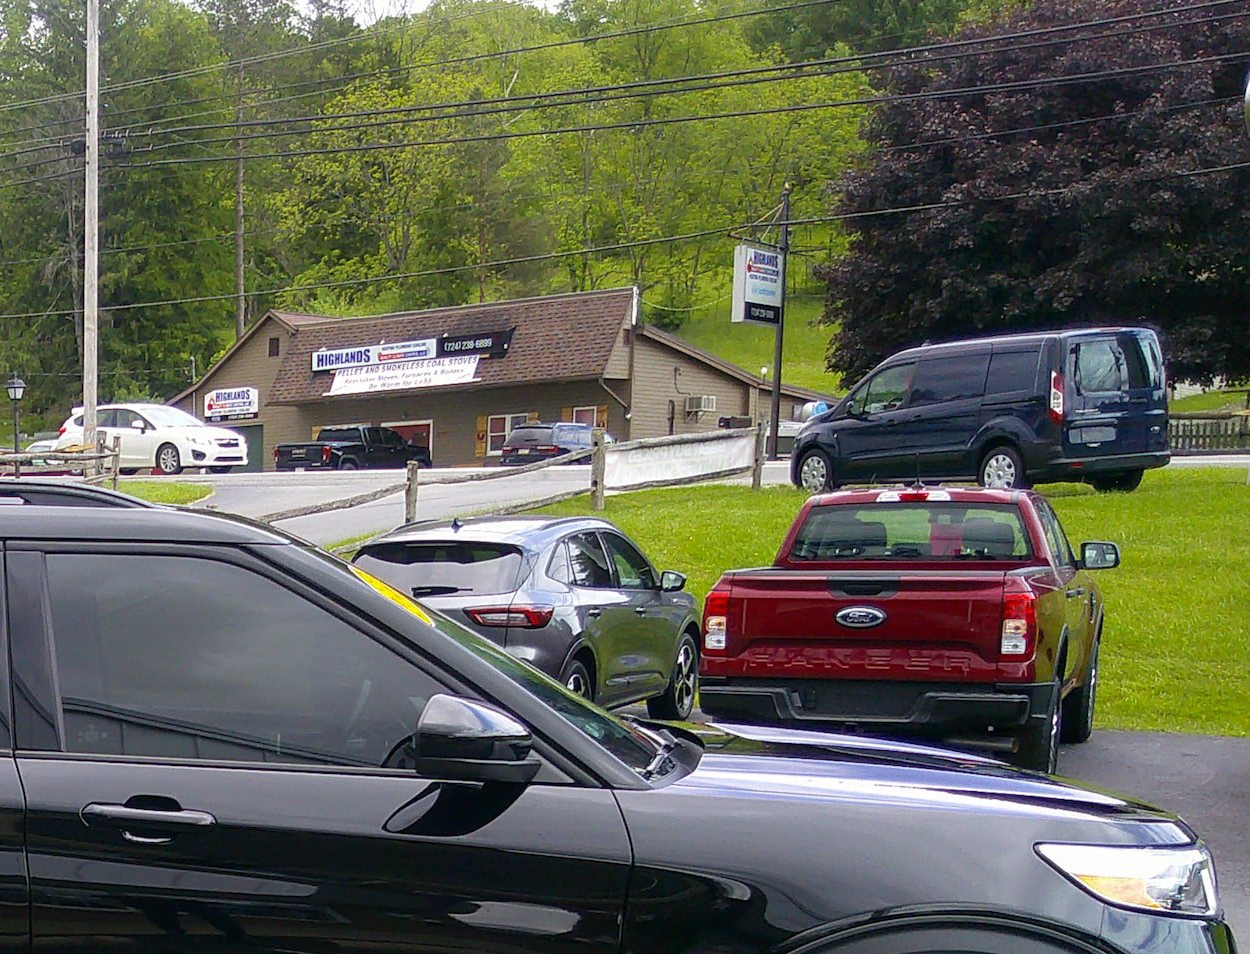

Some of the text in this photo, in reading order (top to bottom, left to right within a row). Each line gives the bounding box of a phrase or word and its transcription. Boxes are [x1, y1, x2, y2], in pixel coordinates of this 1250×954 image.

[444, 341, 461, 351] (724)
[316, 349, 371, 368] HIGHLANDS
[337, 356, 478, 376] PELLET AND SMOKELESS COAL STOVES
[748, 651, 973, 672] RANGER
